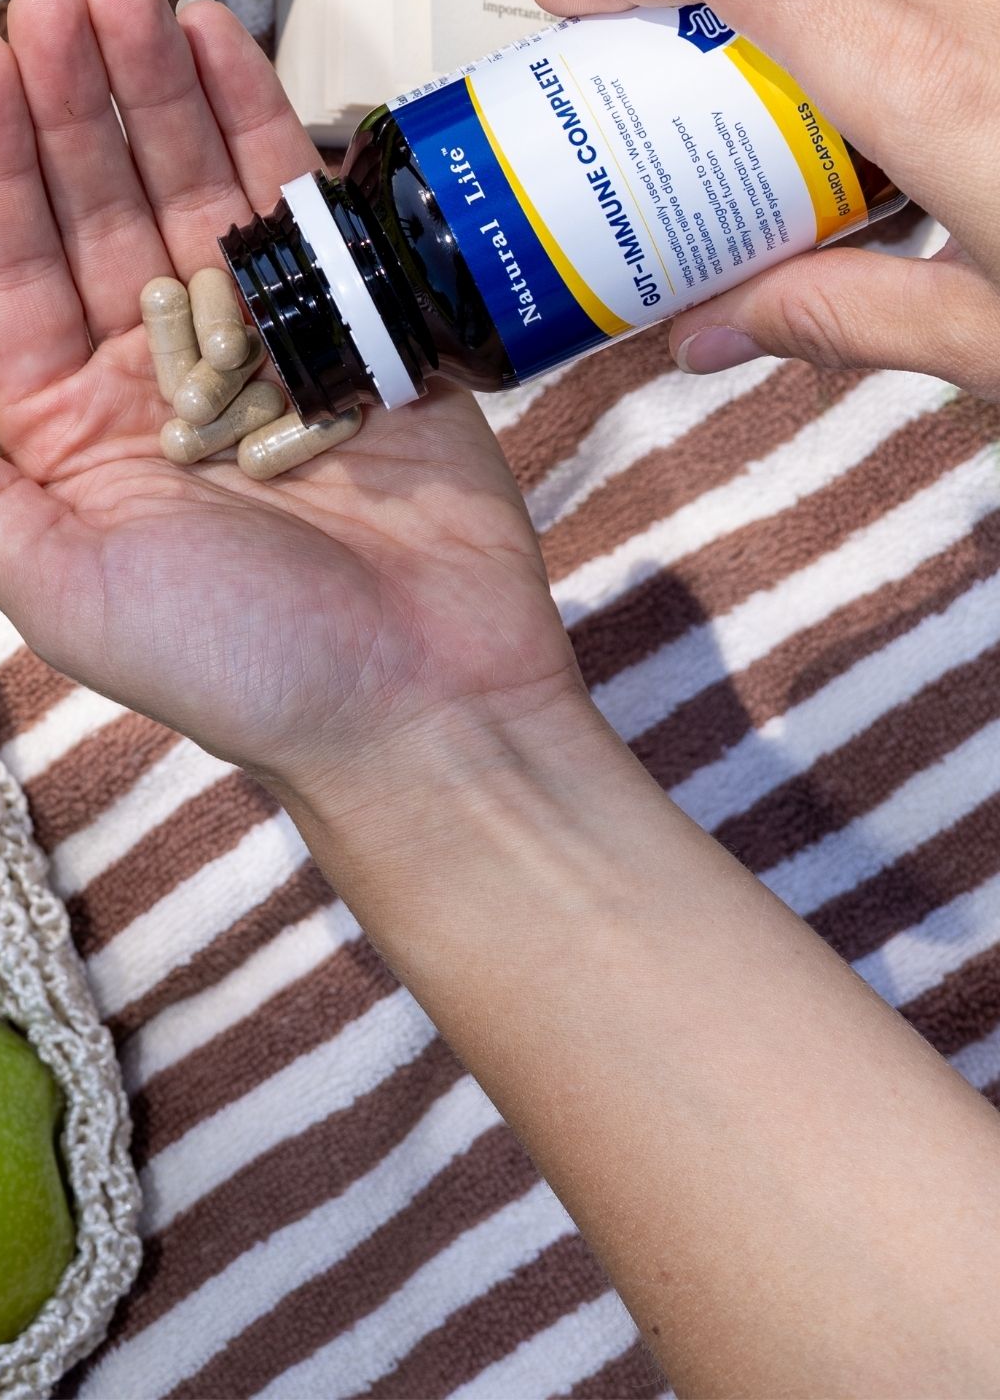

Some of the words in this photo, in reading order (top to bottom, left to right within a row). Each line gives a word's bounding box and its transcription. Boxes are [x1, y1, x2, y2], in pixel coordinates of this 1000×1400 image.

[483, 0, 546, 21] important
[529, 58, 597, 164] COMPLETE
[590, 75, 615, 111] Herbal
[610, 78, 647, 139] discomfort
[611, 111, 639, 160] Western
[672, 116, 701, 164] support
[711, 111, 738, 157] healthy
[734, 121, 762, 172] function
[797, 102, 834, 171] CAPSULES
[636, 160, 647, 174] in
[643, 141, 674, 195] digestive
[696, 165, 707, 179] to
[706, 150, 733, 199] function
[733, 157, 760, 207] maintain
[640, 173, 661, 204] used
[757, 171, 779, 210] system
[827, 172, 848, 204] HARD
[669, 196, 691, 233] relieve
[703, 179, 732, 235] coagulans
[726, 198, 746, 233] bowel
[755, 207, 765, 220] to
[837, 203, 850, 216] 60
[586, 166, 661, 307] GUT-IMMUNE
[656, 205, 688, 267] traditionally
[685, 233, 696, 246] to
[693, 212, 719, 261] flatulence
[740, 230, 757, 261] healthy
[758, 219, 776, 251] Propolis
[772, 210, 790, 245] immune
[690, 245, 710, 282] Medicine
[711, 258, 723, 275] and
[726, 236, 743, 267] Bacillus
[479, 218, 542, 327] Natural
[681, 265, 695, 289] Herbs
